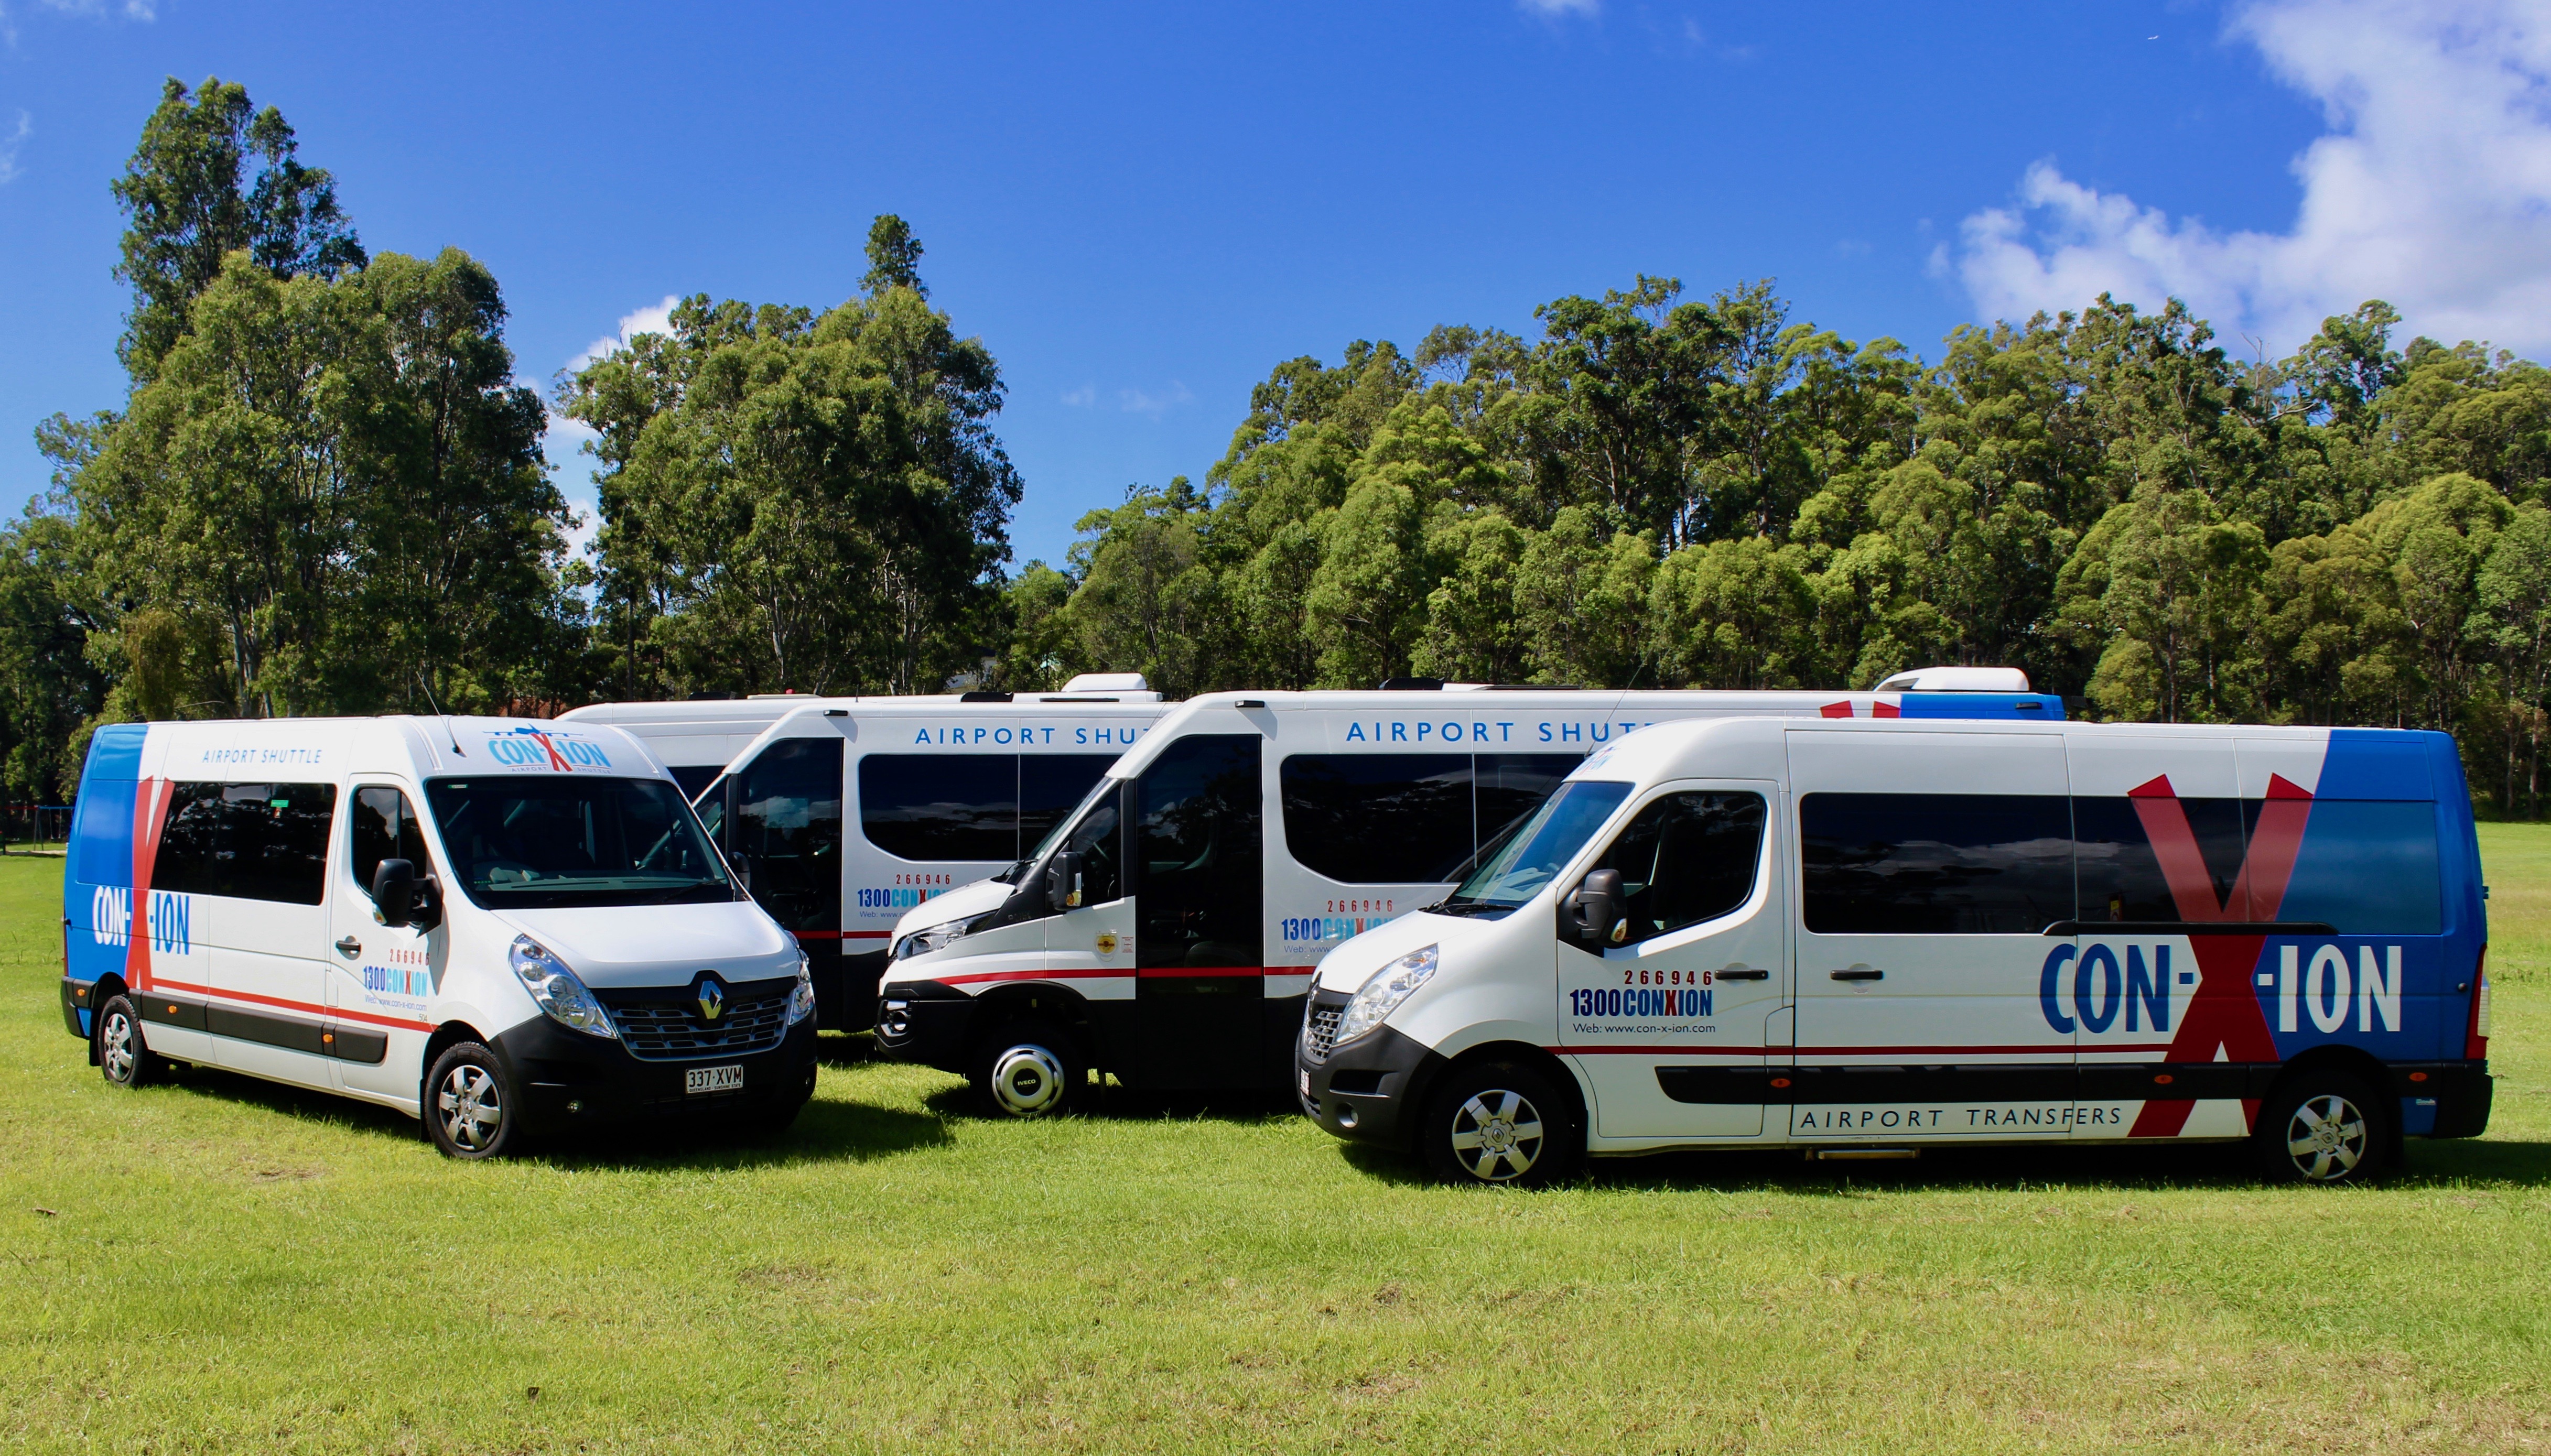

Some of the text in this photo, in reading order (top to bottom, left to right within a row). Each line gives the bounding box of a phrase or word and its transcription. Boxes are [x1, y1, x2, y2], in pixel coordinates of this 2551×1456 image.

[915, 728, 1150, 744] AIRPORT SHU
[1346, 722, 1655, 742] AIRPORT SHUT
[202, 749, 322, 764] AIRPORT SHUTTLE
[896, 874, 950, 885] 266946
[858, 888, 950, 907] 1300CONXI
[1327, 899, 1392, 912] 266946
[1281, 918, 1393, 940] 1300CONXI
[390, 948, 430, 966] 266946
[1625, 970, 1712, 985] 266946
[365, 994, 427, 1012] Web: www.con-x-ion.com
[1573, 1023, 1716, 1033] Web: www.con-x-ion.com
[1801, 1107, 2121, 1128] AIRPORT TRANSFERS
